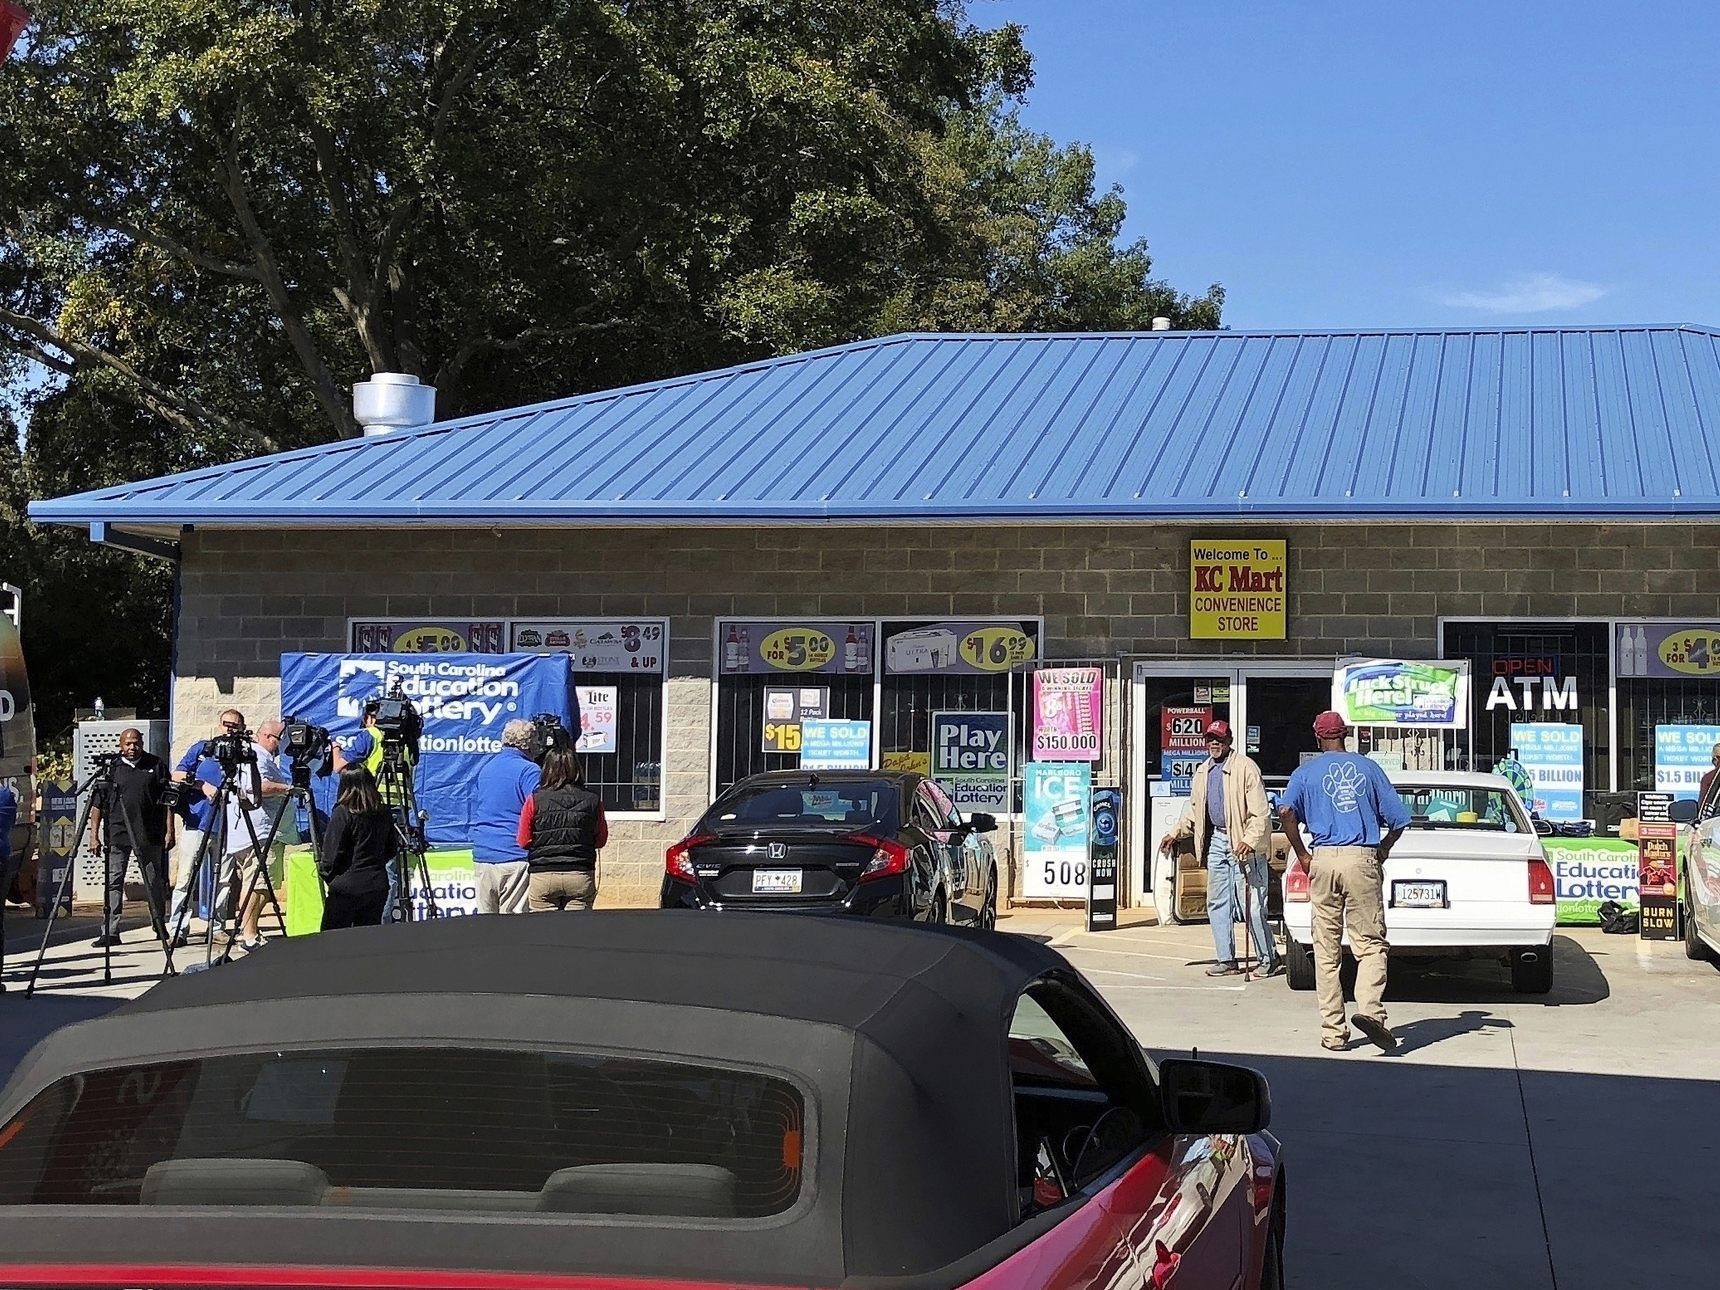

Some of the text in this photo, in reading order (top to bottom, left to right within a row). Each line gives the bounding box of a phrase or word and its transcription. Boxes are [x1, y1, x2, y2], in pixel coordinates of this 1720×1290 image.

[1193, 548, 1250, 560] Welcome
[1253, 548, 1268, 560] To
[1194, 565, 1282, 592] KC Mart
[1195, 597, 1281, 612] CONVENIENCE
[1218, 617, 1258, 631] STORE
[1672, 642, 1678, 652] 3
[767, 651, 784, 660] FOR
[1666, 653, 1685, 663] FOR
[387, 661, 506, 677] South Carolina
[643, 657, 657, 668] UP
[1494, 660, 1552, 674] OPEN
[1038, 671, 1097, 684] WE SOLD
[588, 690, 609, 705] Lite
[1485, 676, 1577, 710] ATM
[415, 697, 503, 725] ottery
[804, 727, 867, 739] WE SOLD
[940, 724, 1003, 752] Play
[1514, 731, 1579, 743] WE SOLD
[1658, 731, 1681, 744] WE
[1037, 735, 1097, 750] $150,000
[1169, 738, 1206, 747] MILLION
[939, 746, 1007, 769] Here
[1540, 769, 1582, 782] BILLION
[1657, 770, 1681, 783] $1.5
[1034, 776, 1081, 800] ICE
[1170, 780, 1192, 789] MILL
[954, 792, 1003, 805] Lottery
[1093, 802, 1112, 812] CAMEL
[1647, 840, 1668, 853] Dutch
[1557, 850, 1640, 862] South Caroli
[1092, 859, 1116, 868] CRUSH
[1556, 861, 1640, 879] Educati
[1044, 861, 1086, 885] 508
[1096, 869, 1112, 877] NOW
[756, 875, 798, 886] PFY 428
[1643, 907, 1674, 917] BURN
[1643, 918, 1674, 928] SLOW
